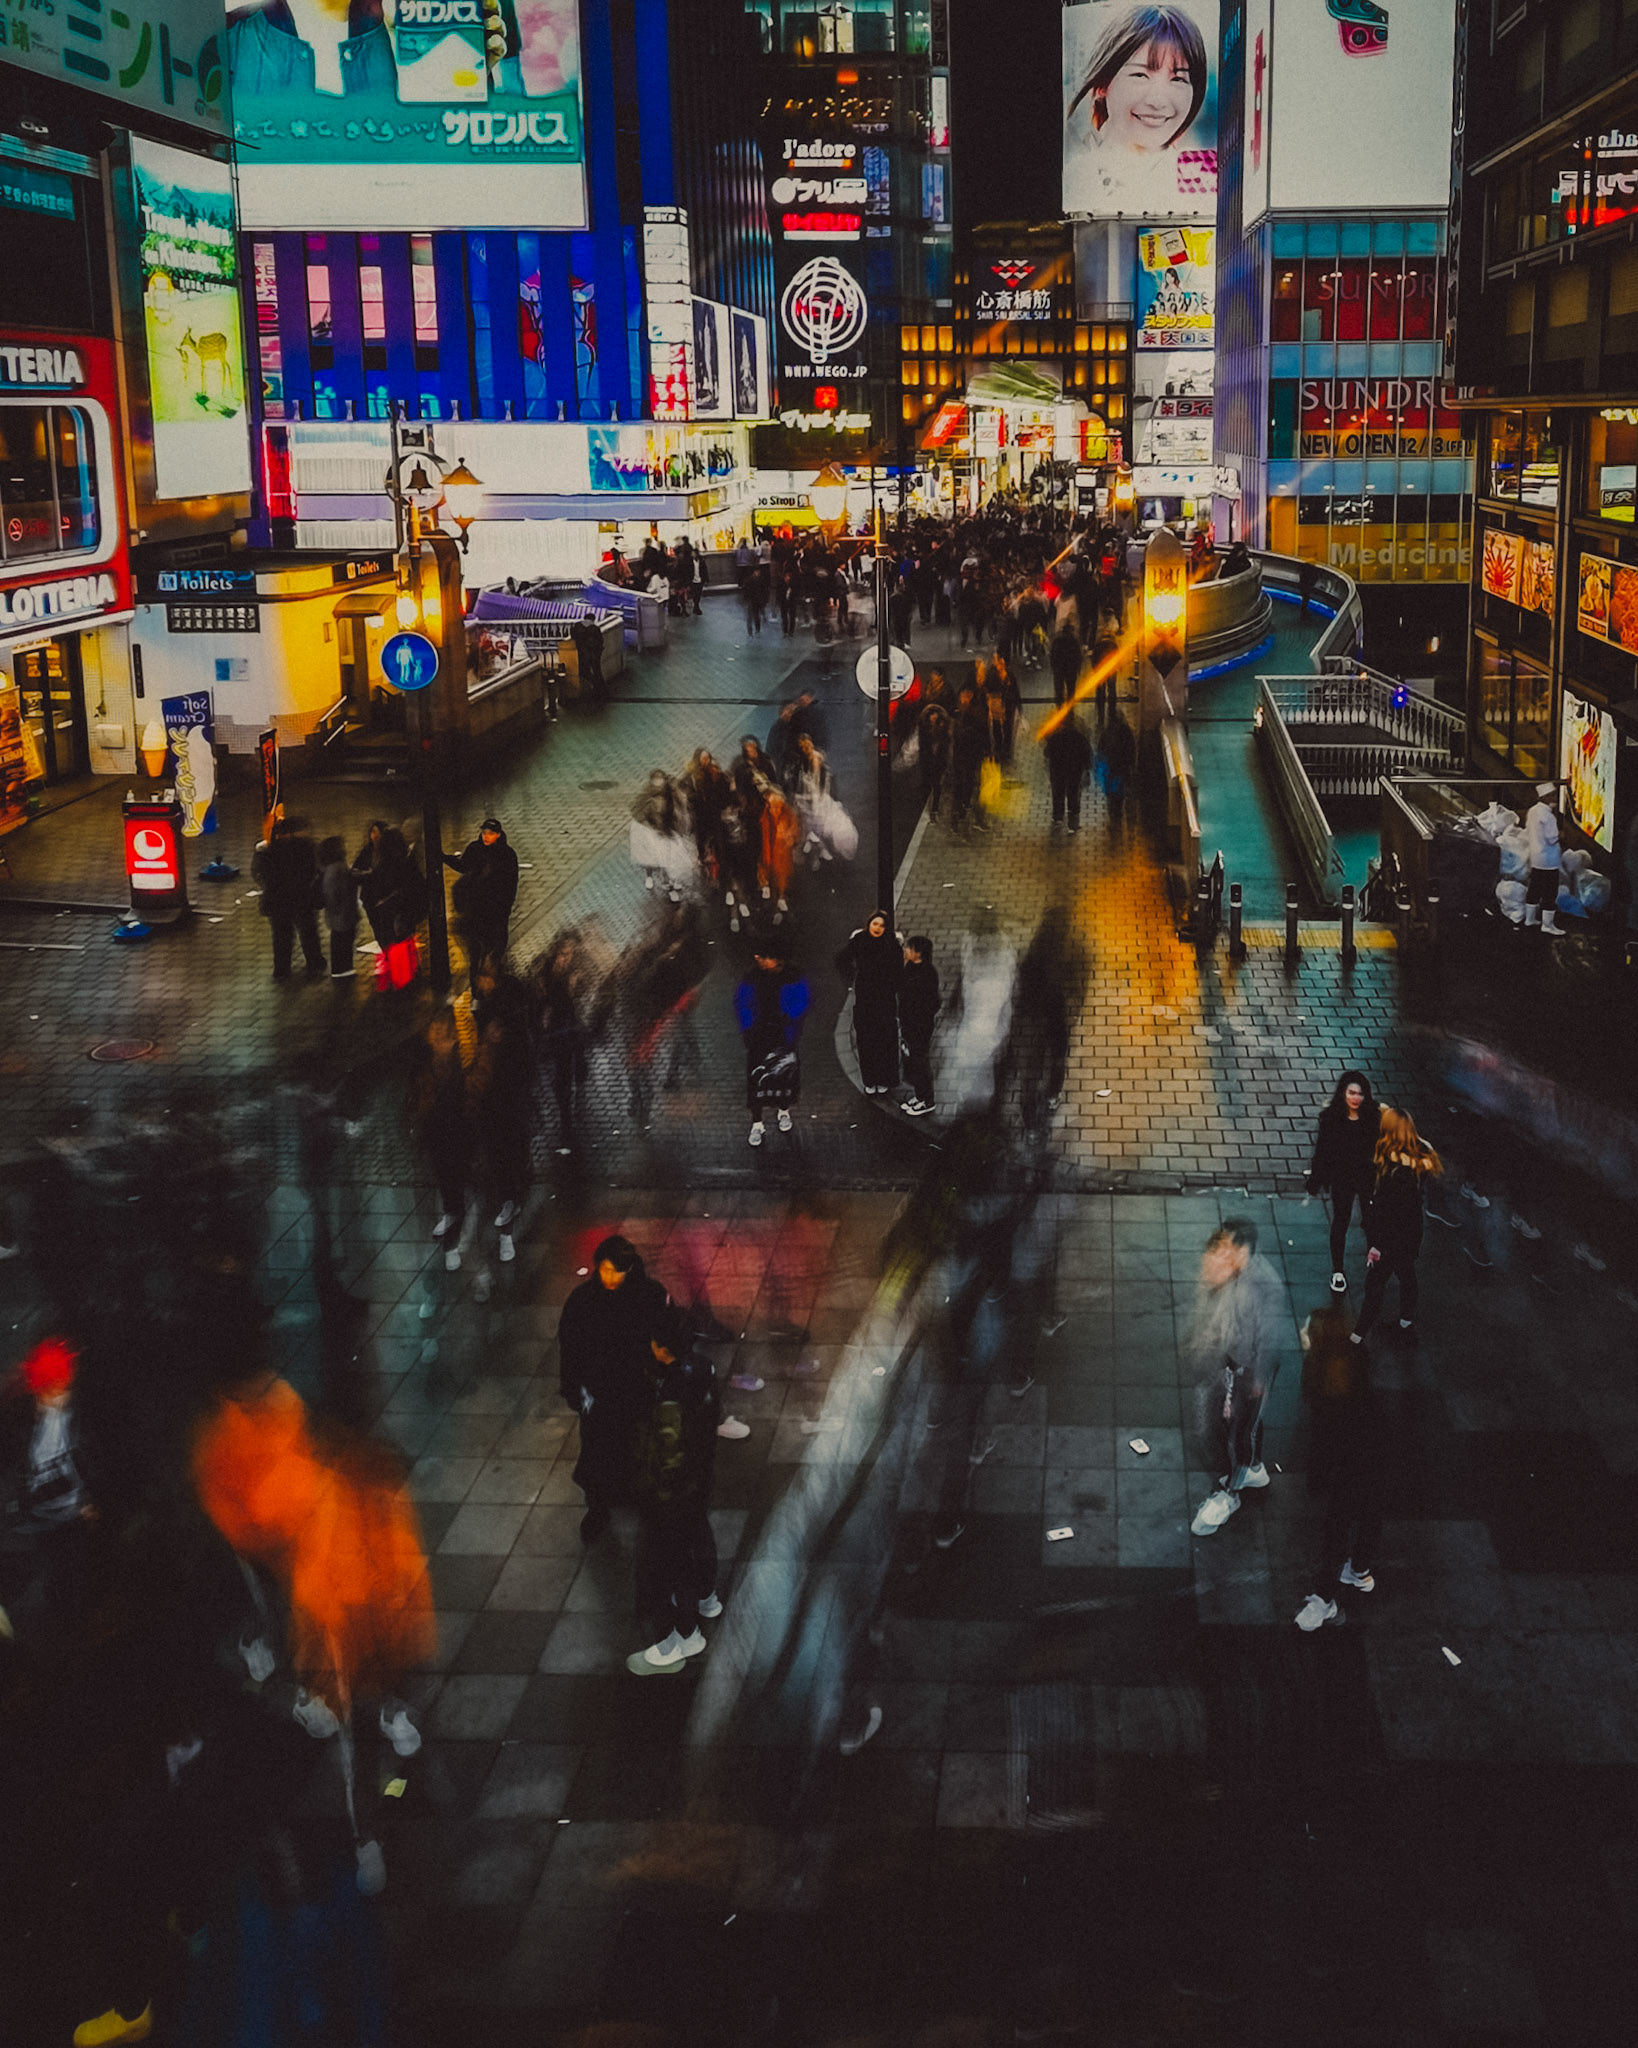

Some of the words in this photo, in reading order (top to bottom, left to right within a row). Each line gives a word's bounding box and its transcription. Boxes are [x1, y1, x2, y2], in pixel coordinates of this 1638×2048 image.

[441, 110, 568, 145] サロンパス
[782, 139, 856, 159] J'adore
[976, 288, 1052, 310] 心斎橋筋
[784, 365, 868, 378] WWW.WEGO.JP
[1301, 434, 1343, 455] NEW
[1345, 433, 1398, 456] OPEN
[1330, 541, 1471, 566] Medicine
[181, 574, 233, 590] Toilets
[0, 573, 116, 625] LOTTERIA
